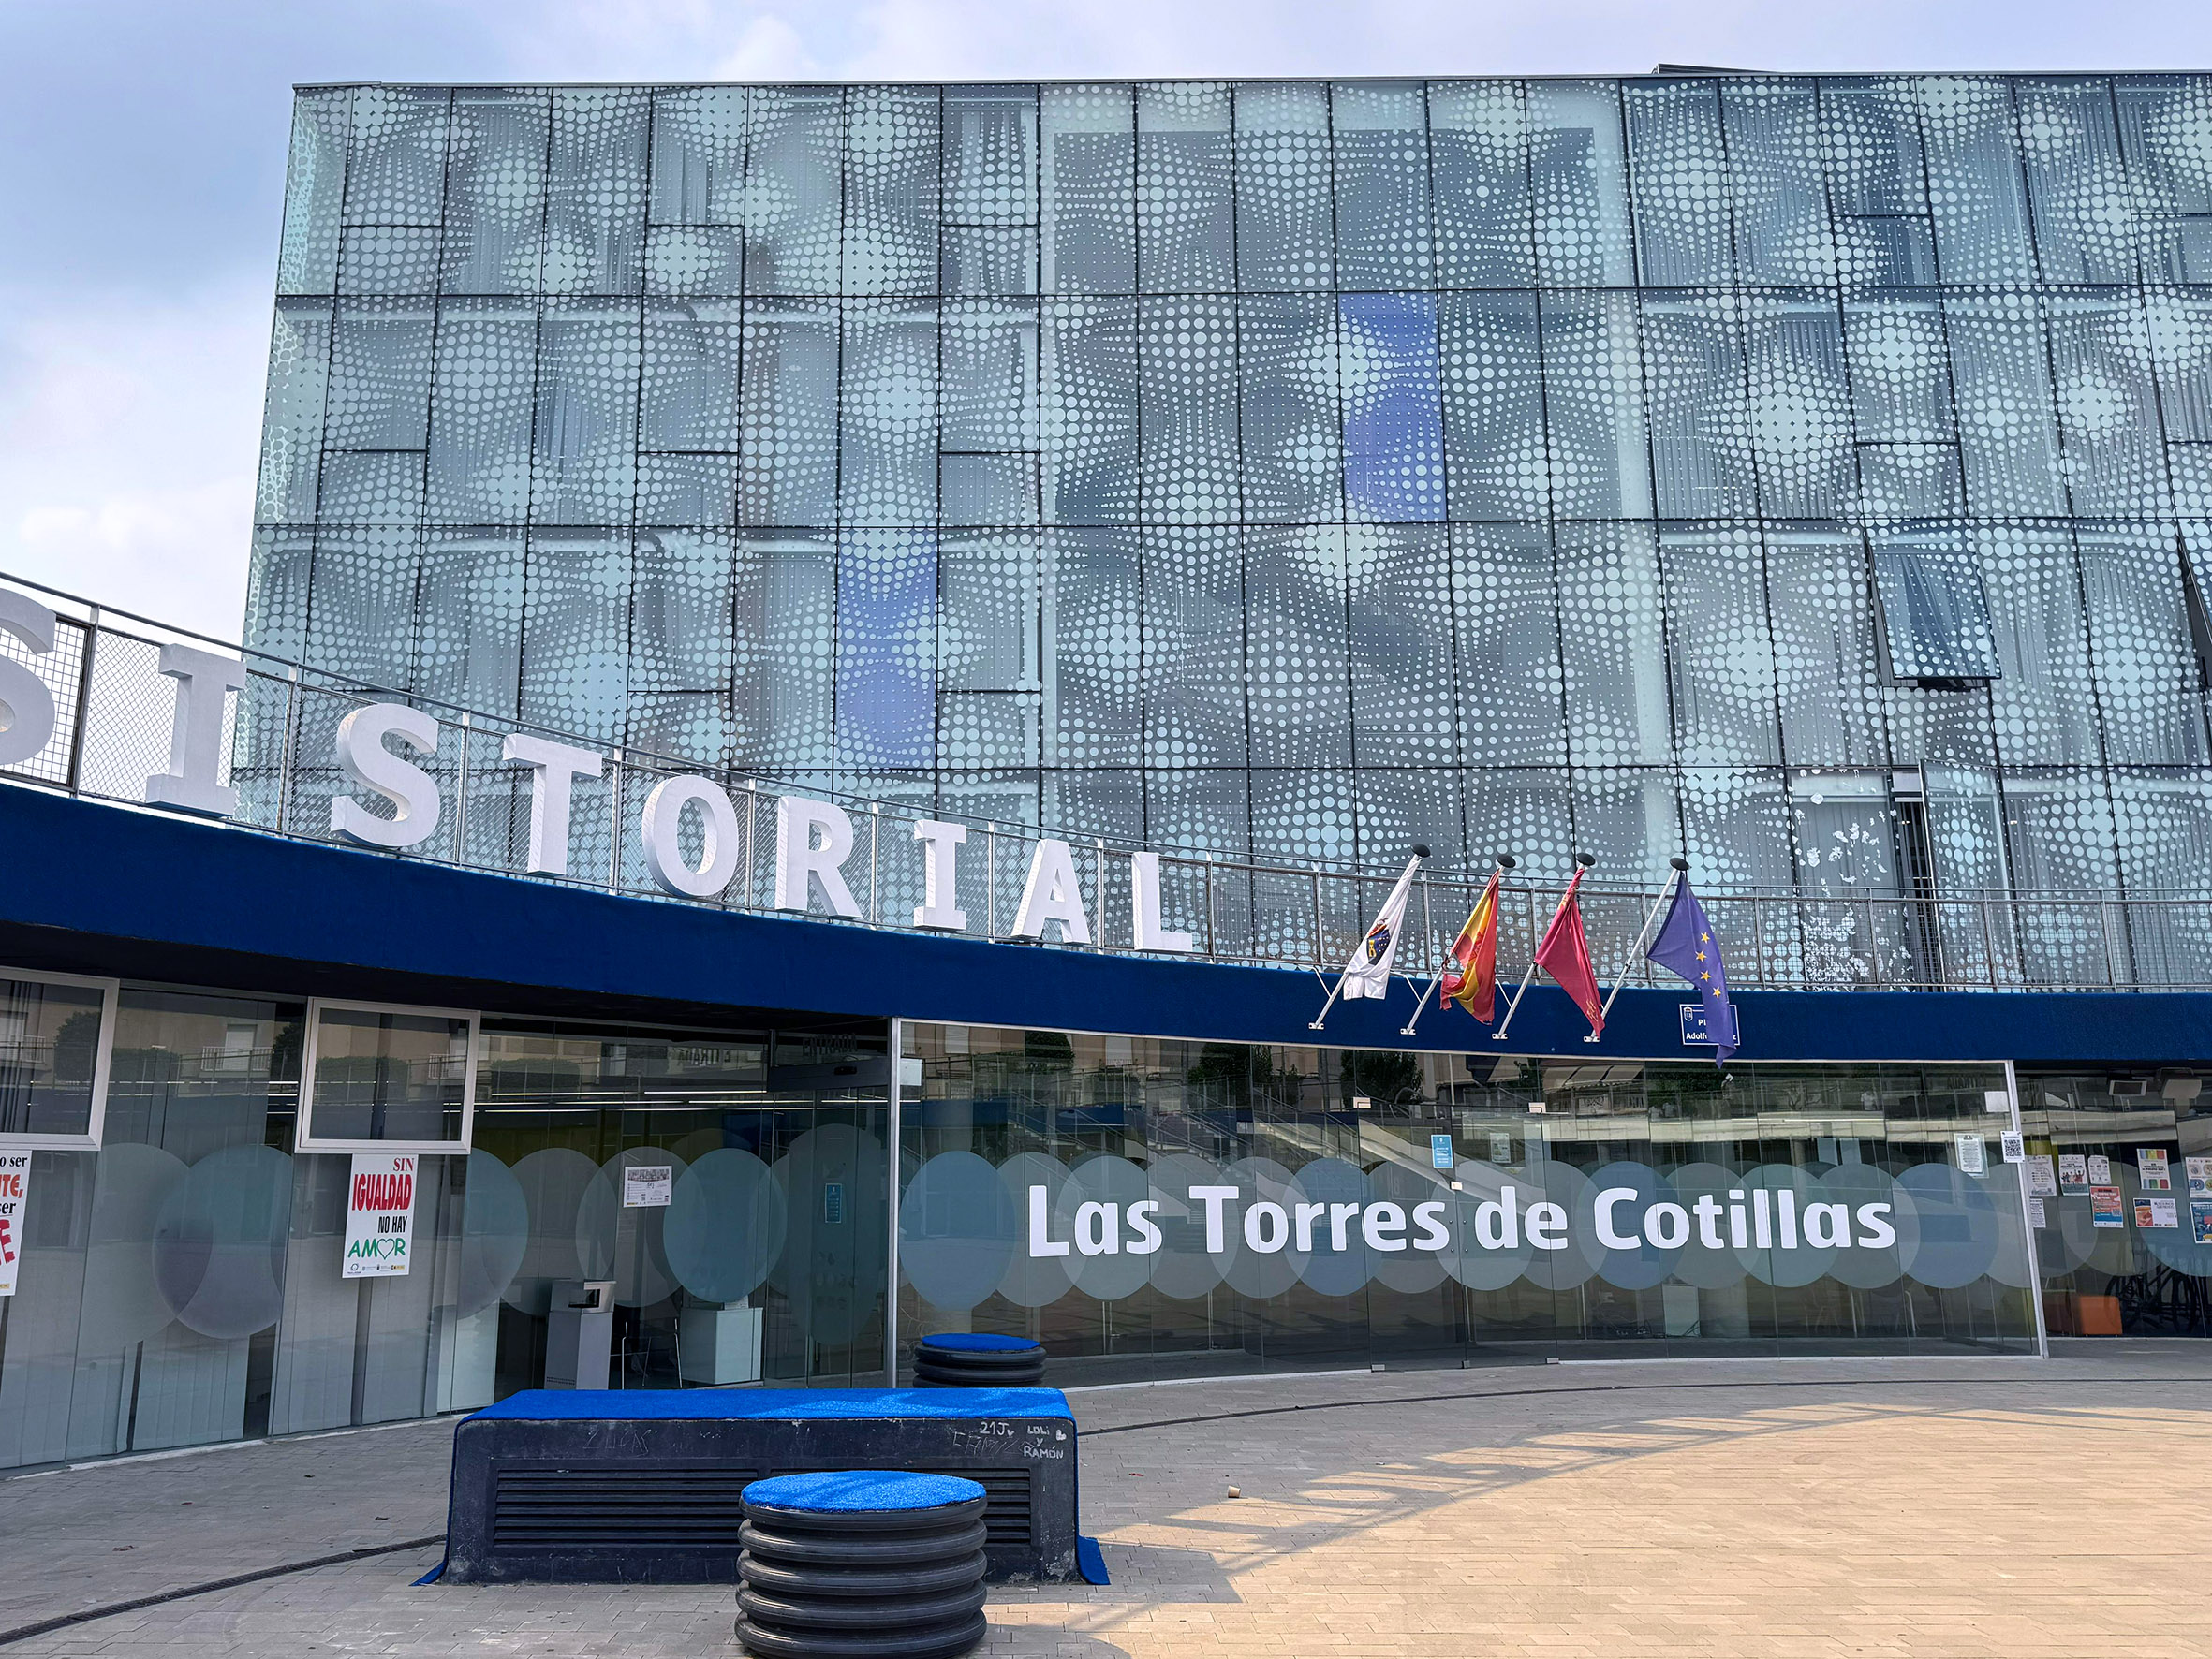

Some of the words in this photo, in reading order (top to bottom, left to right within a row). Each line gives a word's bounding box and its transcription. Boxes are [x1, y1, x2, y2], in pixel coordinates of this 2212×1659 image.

[9, 1156, 28, 1167] ser
[393, 1158, 414, 1172] SIN
[352, 1173, 412, 1211] IGUALDAD
[377, 1216, 390, 1233] NO
[391, 1216, 407, 1233] HAY
[1029, 1185, 1162, 1257] Las
[1188, 1185, 1450, 1254] Torres
[1474, 1185, 1569, 1250] de
[1594, 1187, 1897, 1250] Cotillas
[1023, 1445, 1064, 1459] RAMÓN
